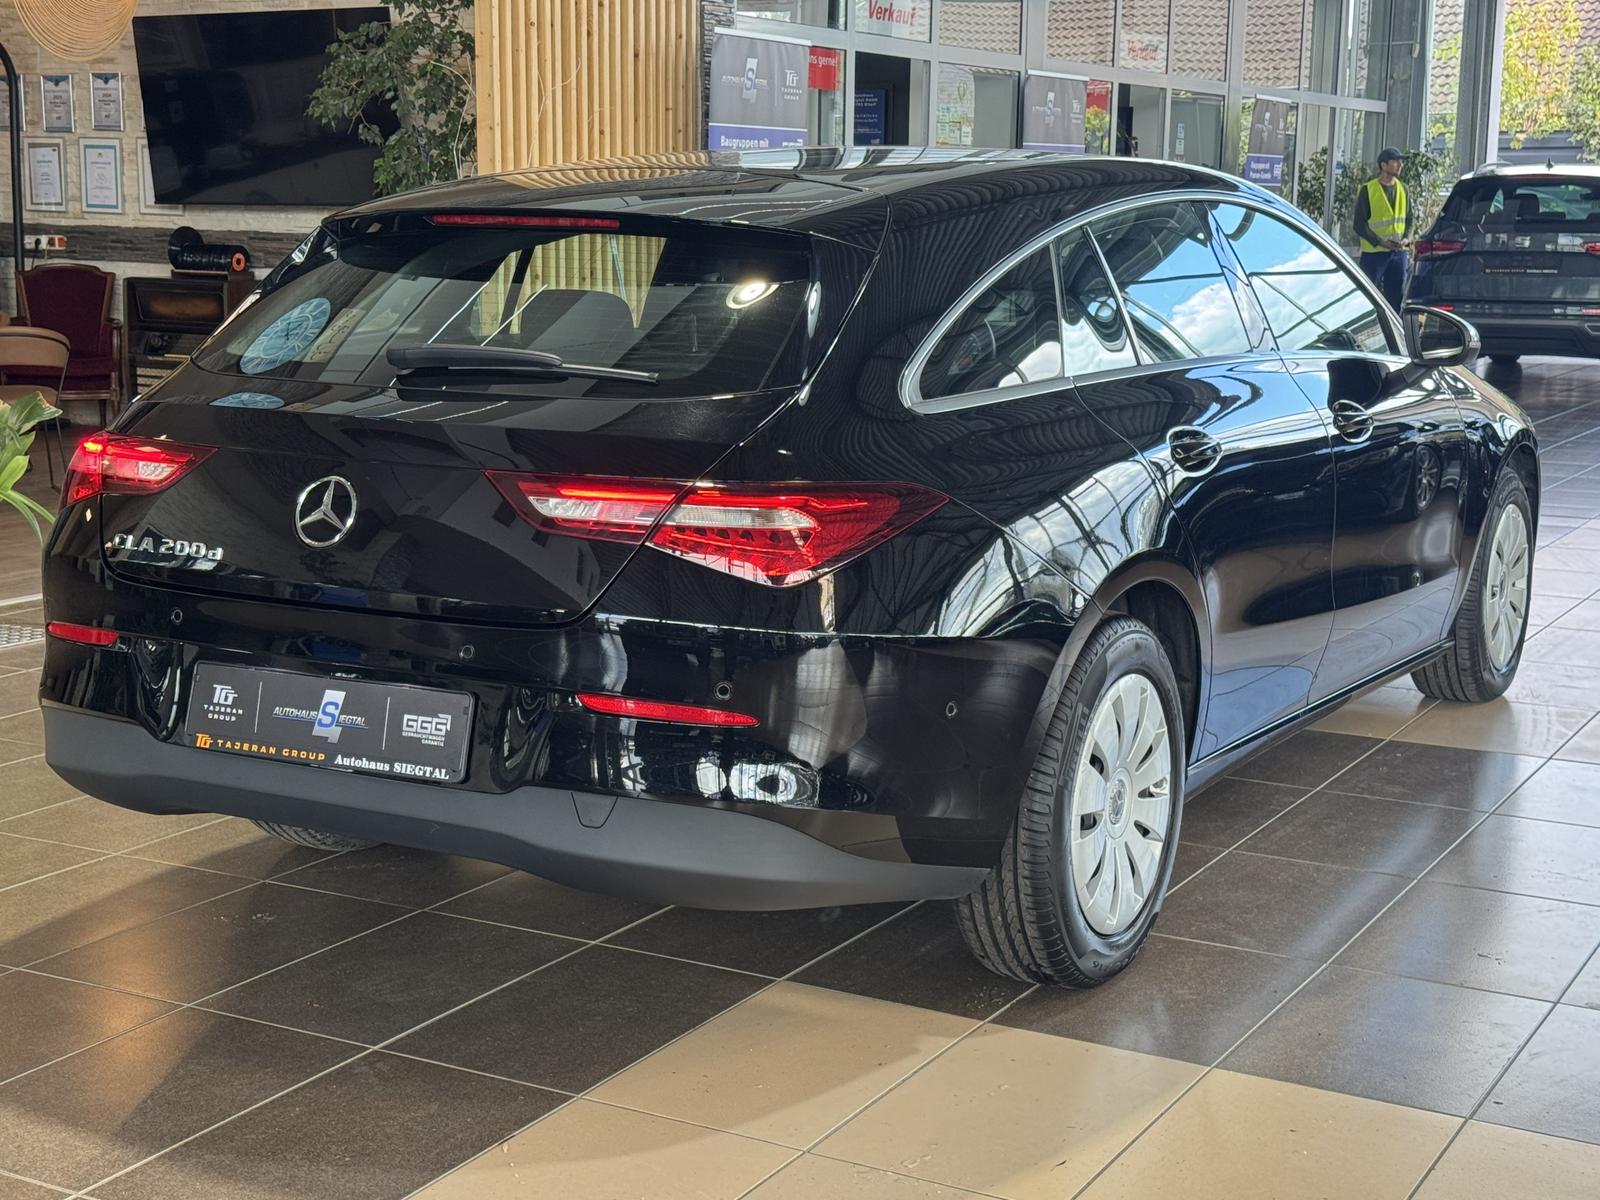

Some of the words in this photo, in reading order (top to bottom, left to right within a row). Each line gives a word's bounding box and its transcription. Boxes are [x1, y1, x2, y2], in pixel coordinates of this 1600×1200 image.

[112, 533, 154, 553] CLA
[203, 704, 243, 715] TAJERAN
[208, 713, 236, 721] GROUP
[273, 706, 318, 720] AUTOHAUS
[402, 713, 448, 736] GGG
[216, 739, 277, 755] TAJERAN
[282, 748, 326, 761] GROUP
[334, 754, 391, 772] Autohaus
[393, 762, 450, 780] SIEGTAL
